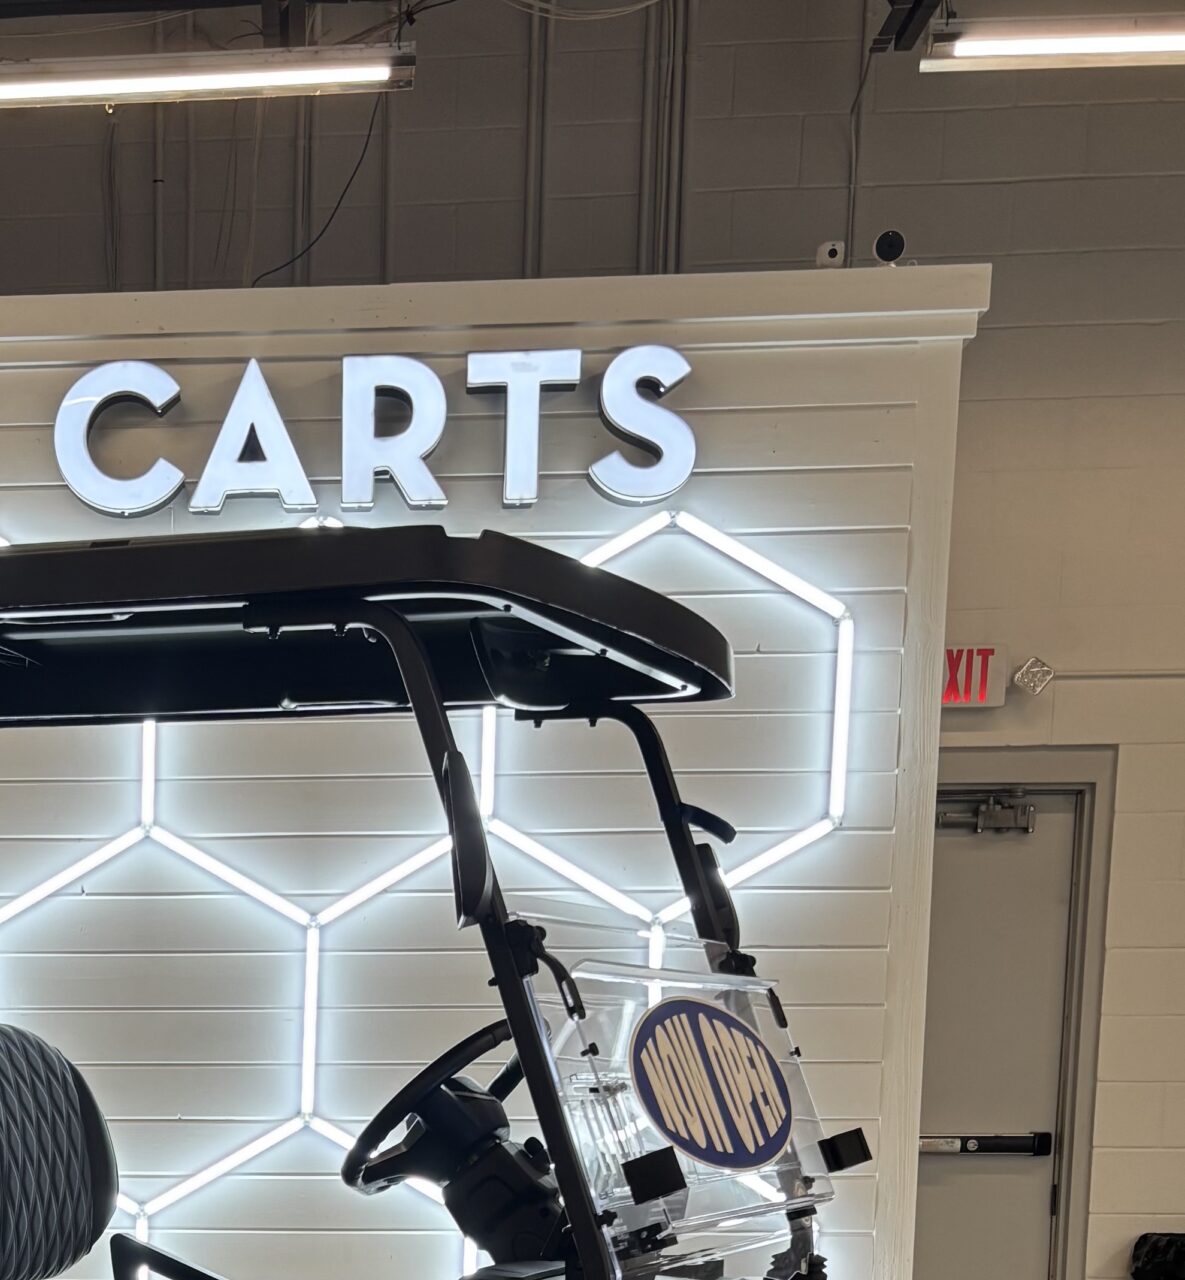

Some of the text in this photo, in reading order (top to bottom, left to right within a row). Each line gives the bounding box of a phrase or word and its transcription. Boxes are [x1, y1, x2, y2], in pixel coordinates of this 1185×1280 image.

[53, 344, 697, 515] CARTS
[942, 648, 995, 704] XIT
[640, 1012, 787, 1154] NOW OPEN
